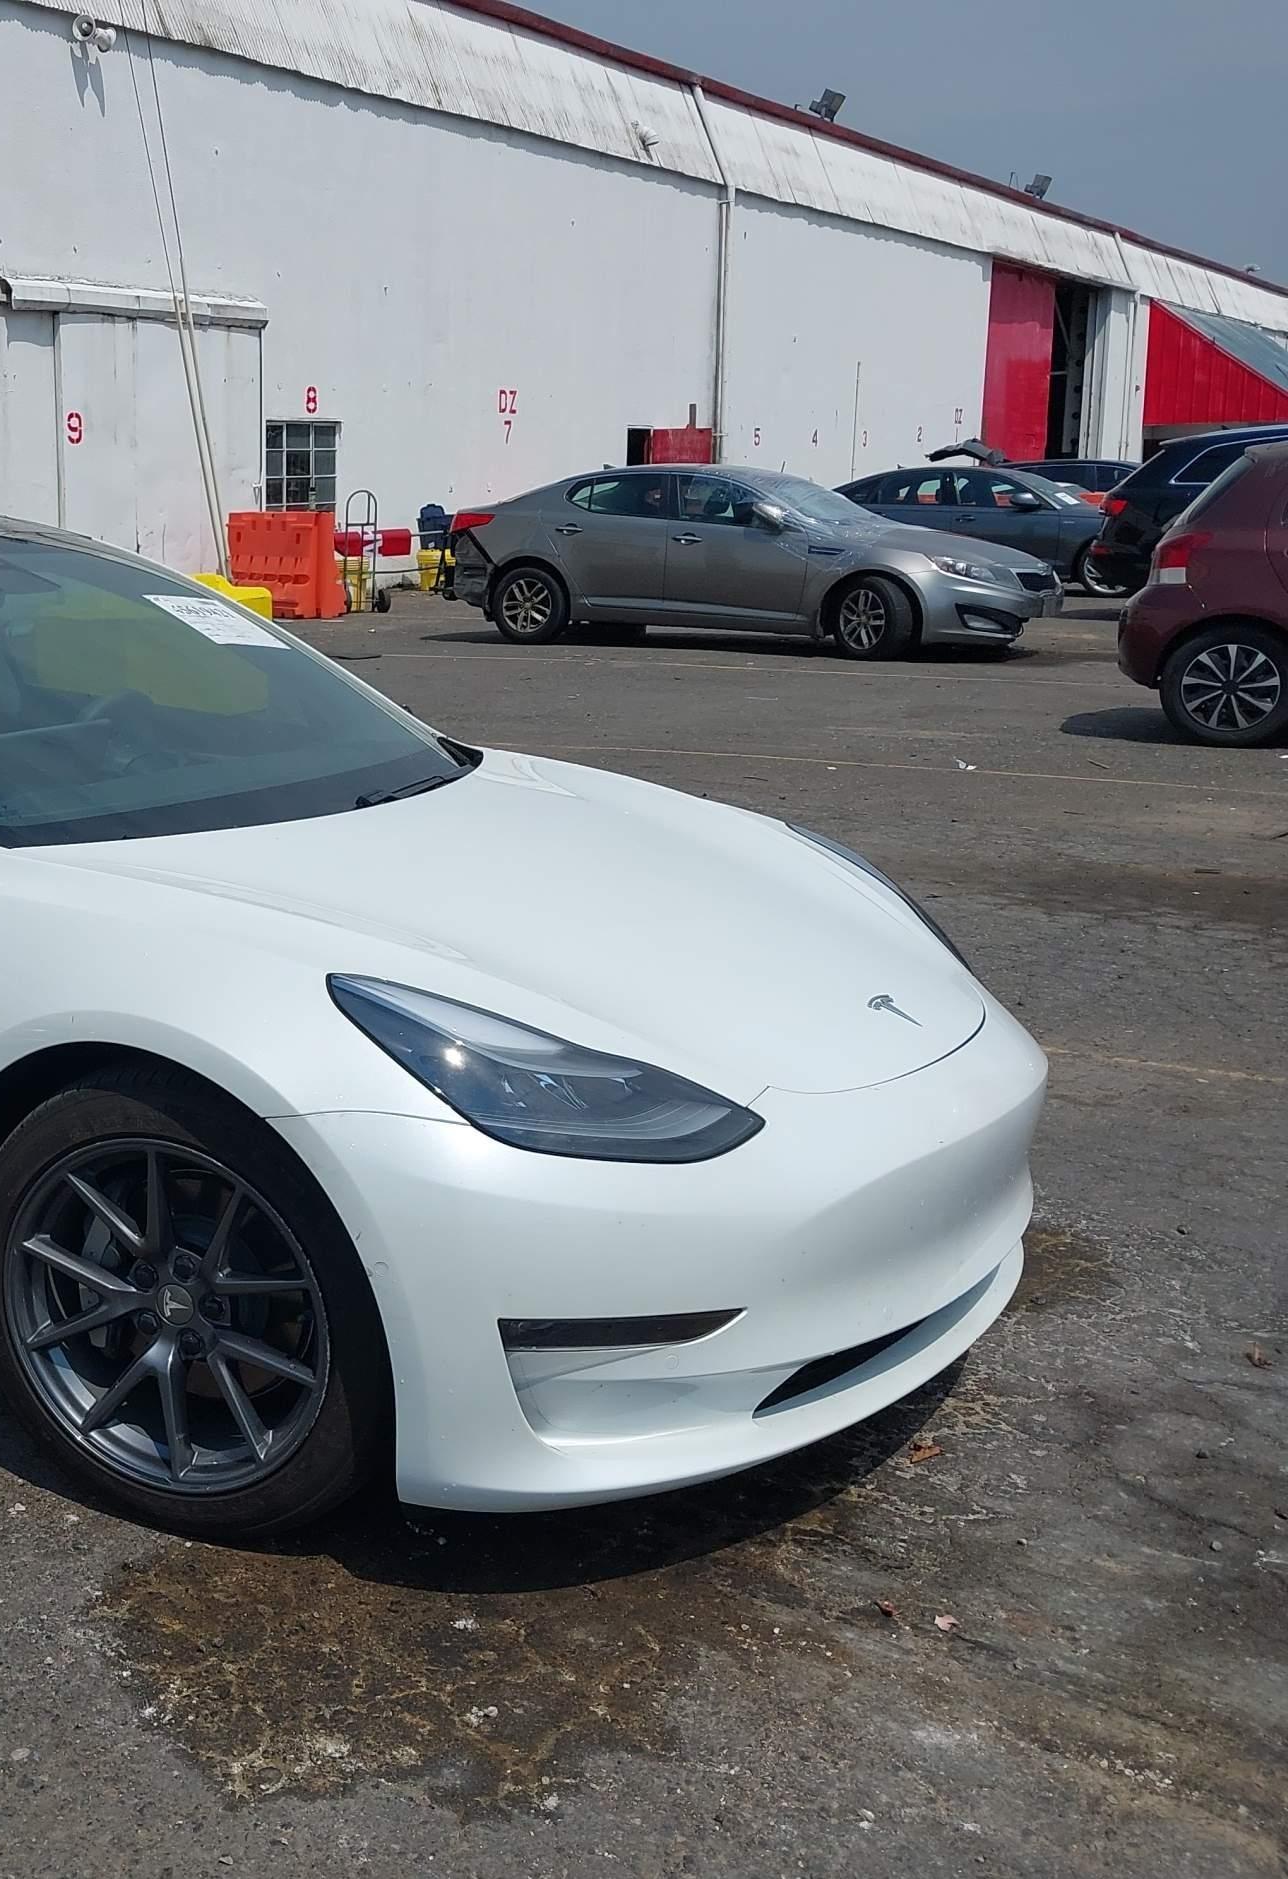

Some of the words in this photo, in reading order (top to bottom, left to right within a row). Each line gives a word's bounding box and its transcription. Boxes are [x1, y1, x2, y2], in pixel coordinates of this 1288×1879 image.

[306, 386, 317, 414] 8
[499, 389, 517, 414] DZ
[67, 412, 82, 444] 9
[504, 420, 512, 444] 7
[754, 427, 761, 446] 5
[812, 428, 817, 447] 4
[917, 426, 922, 442] 2
